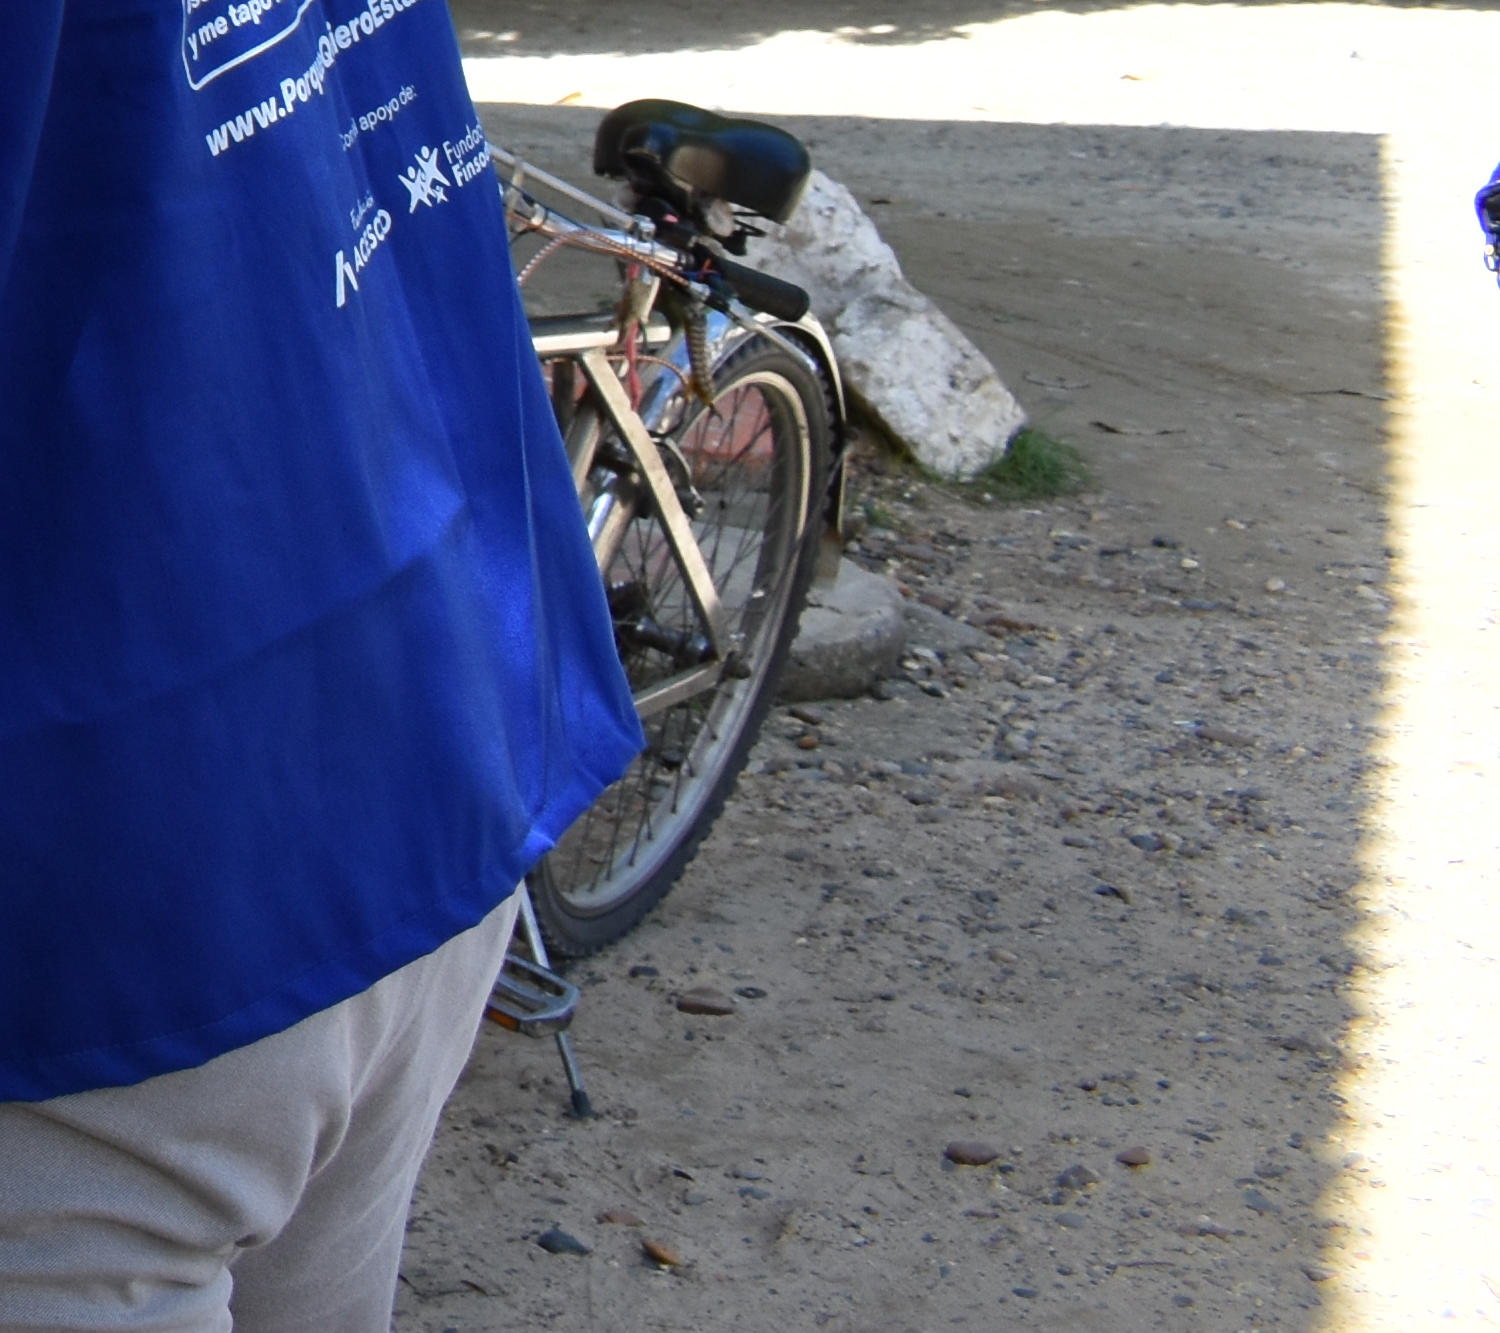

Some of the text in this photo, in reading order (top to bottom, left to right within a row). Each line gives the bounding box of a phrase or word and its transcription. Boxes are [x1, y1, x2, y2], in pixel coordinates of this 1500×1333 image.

[187, 32, 198, 61] y
[198, 15, 229, 46] me
[358, 96, 400, 132] apoyo
